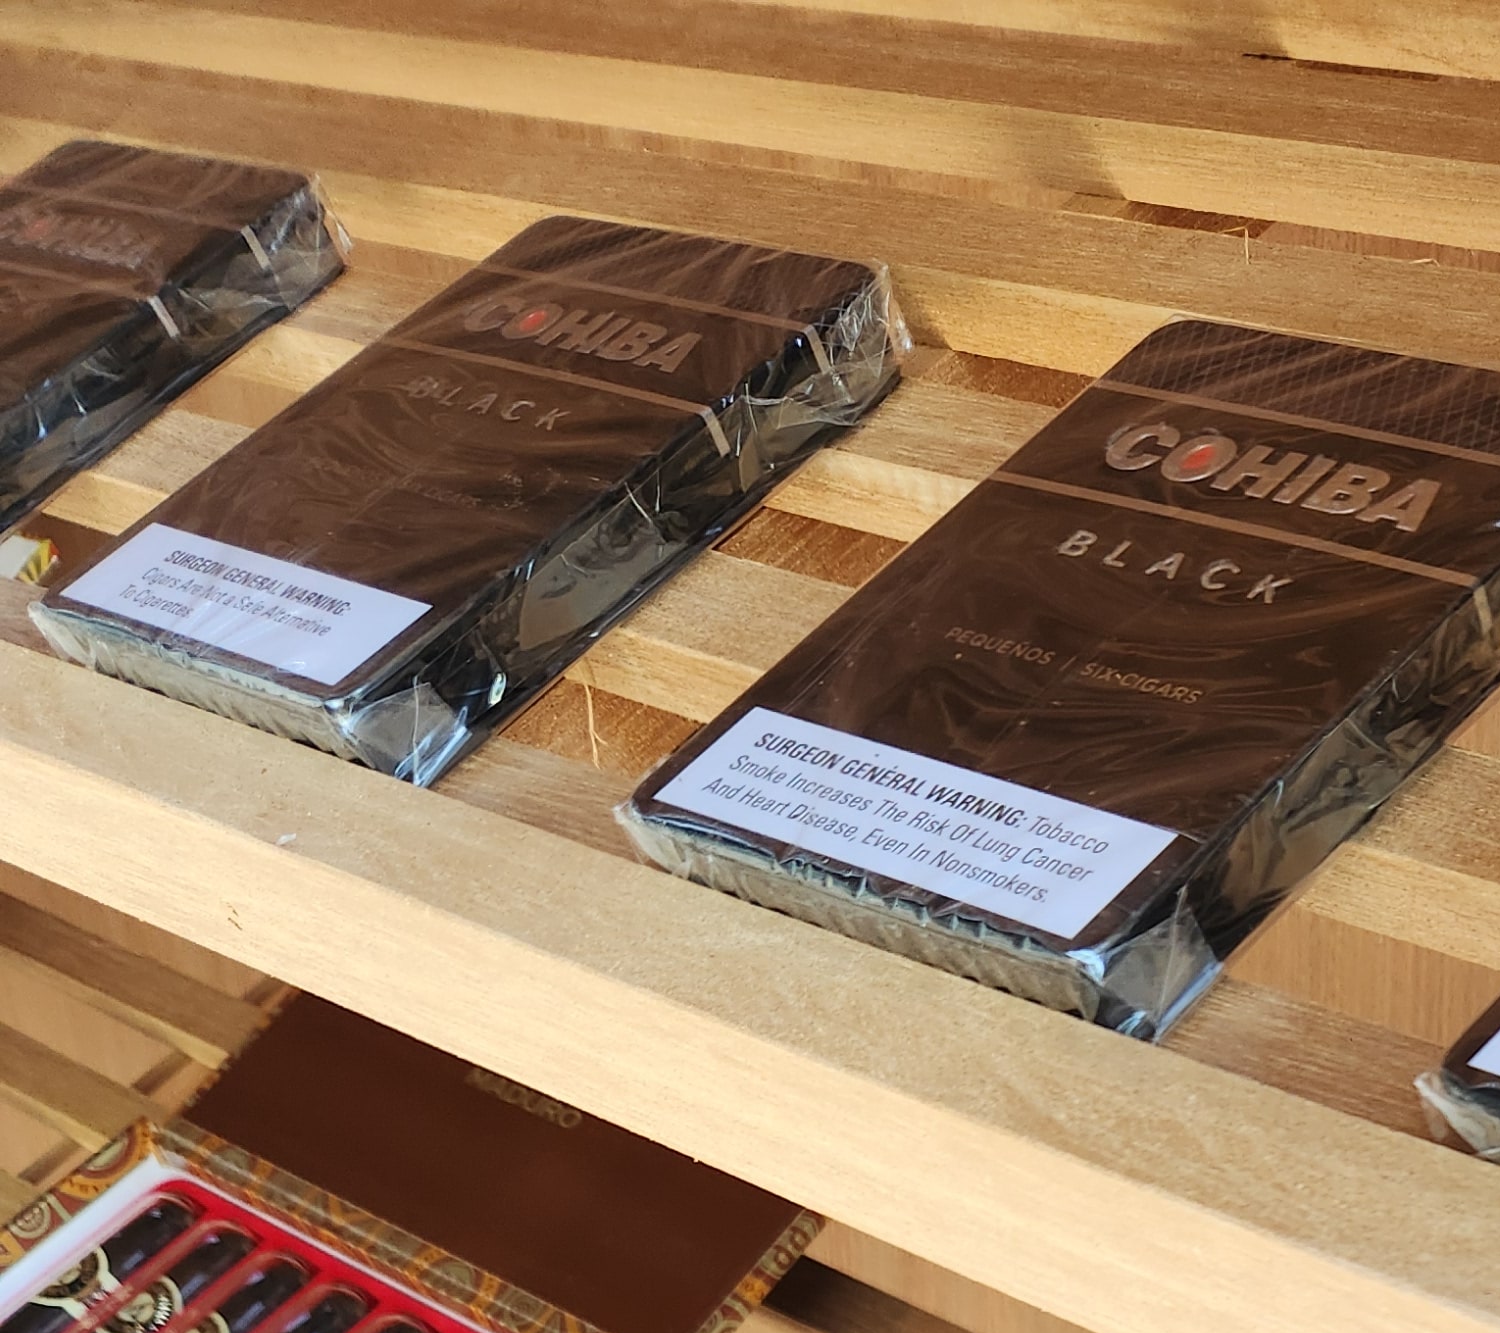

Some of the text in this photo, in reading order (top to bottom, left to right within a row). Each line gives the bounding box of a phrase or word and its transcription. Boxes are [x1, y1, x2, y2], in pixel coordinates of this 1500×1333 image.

[464, 298, 702, 374] COHIBA
[408, 376, 573, 432] BLACK
[1105, 420, 1443, 532] COHIBA
[164, 550, 351, 617] SURGEON GENERAL WARNING:
[1057, 529, 1293, 604] BLACK
[1113, 671, 1203, 705] CIGARS
[729, 754, 1095, 883] Smoke Increases The Risk Of Lung Cancer
[754, 732, 1109, 855] SURGEON GENERAL WARNING: Tobacco
[702, 777, 1048, 904] And Heart Disease, Even In Nonsmokers.
